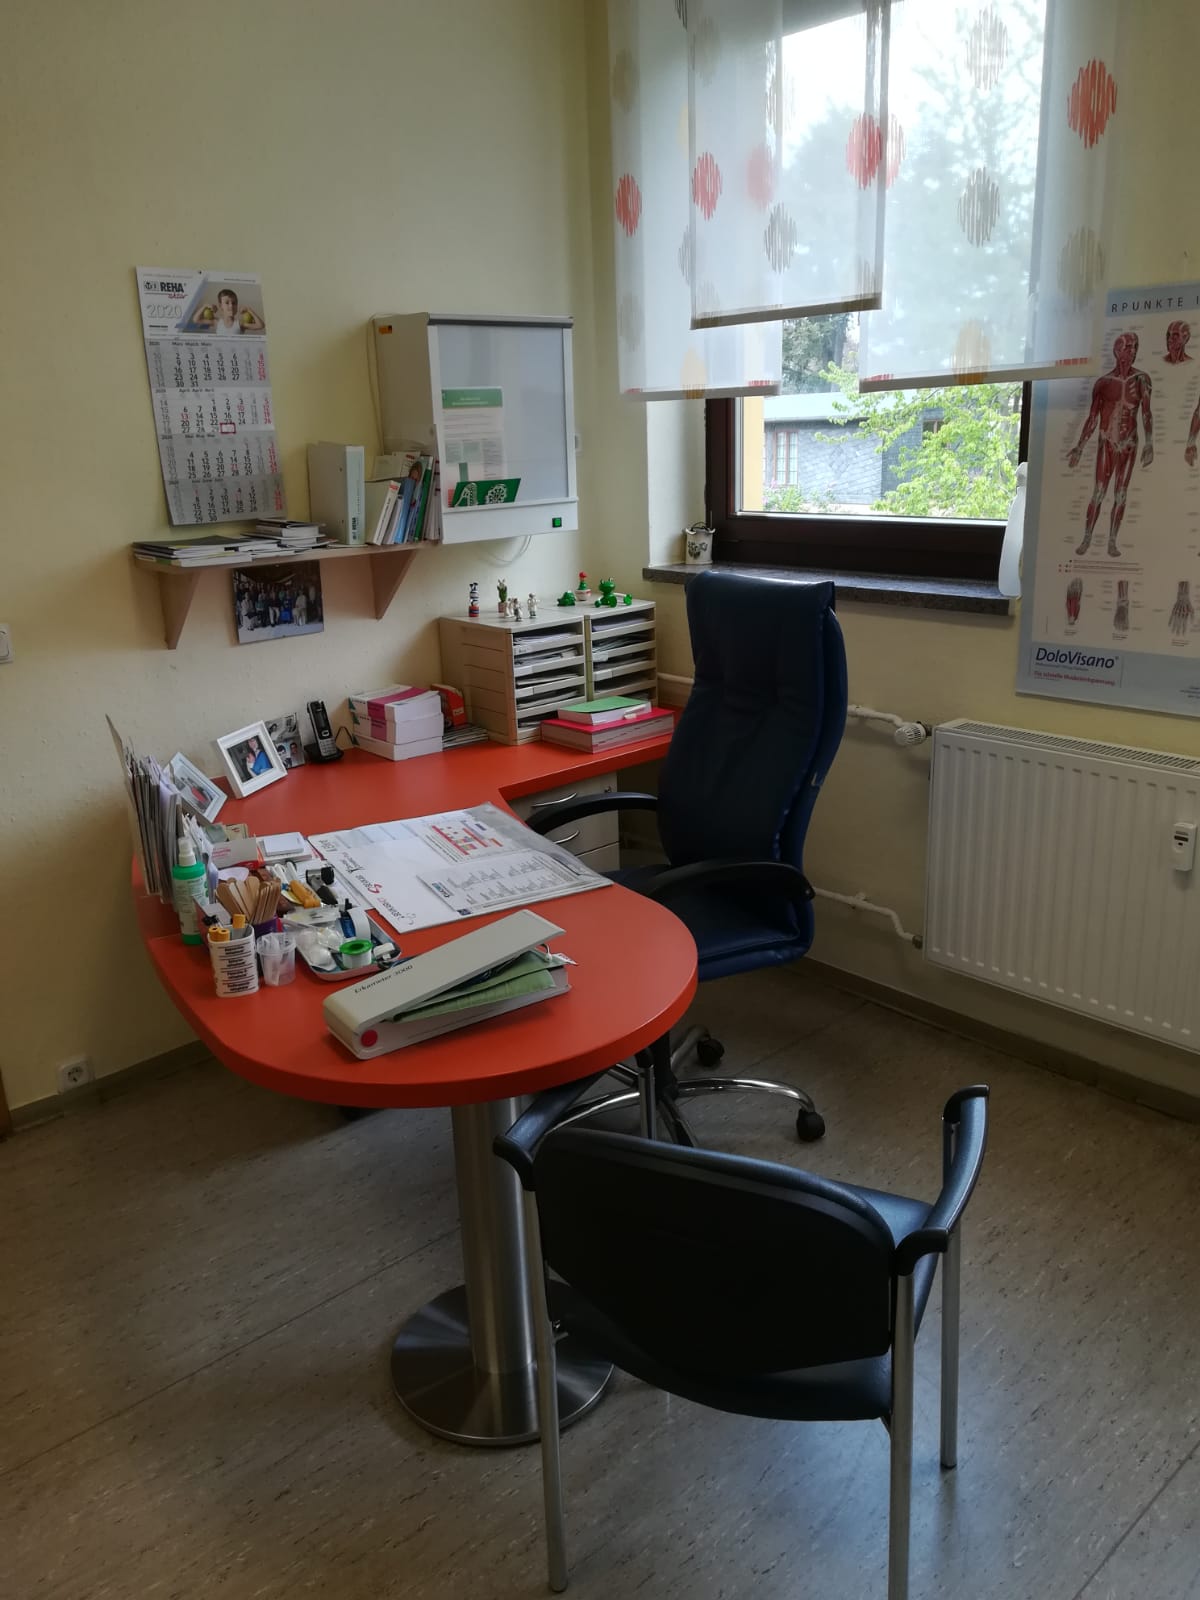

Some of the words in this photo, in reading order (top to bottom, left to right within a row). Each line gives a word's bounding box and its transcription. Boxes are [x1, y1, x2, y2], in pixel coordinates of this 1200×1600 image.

[160, 282, 185, 293] REHA
[147, 304, 183, 319] 2020
[1036, 648, 1114, 668] DoloVisano
